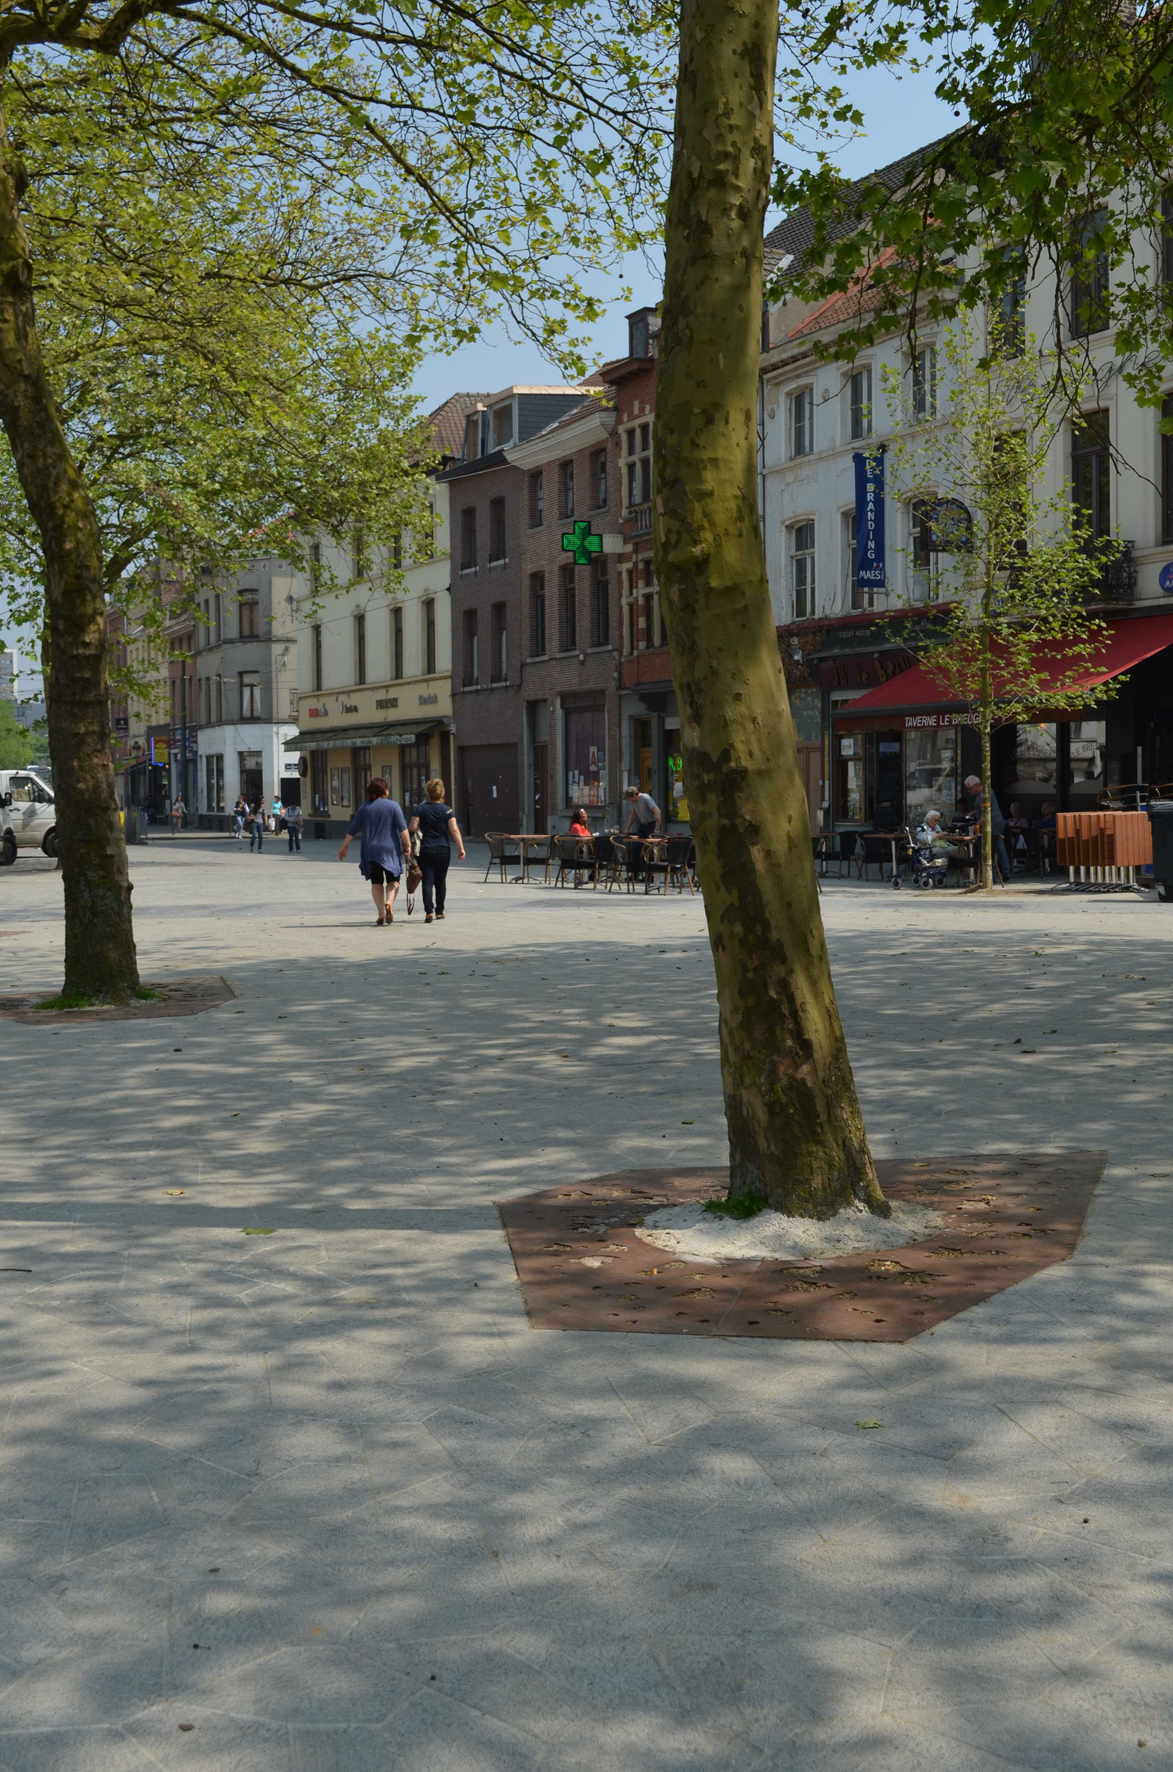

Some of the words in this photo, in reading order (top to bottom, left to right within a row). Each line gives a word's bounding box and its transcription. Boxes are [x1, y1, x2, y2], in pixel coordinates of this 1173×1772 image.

[866, 483, 875, 559] BRANDING
[859, 570, 881, 580] MAES
[904, 715, 938, 727] TAVERNE
[940, 714, 950, 726] LE
